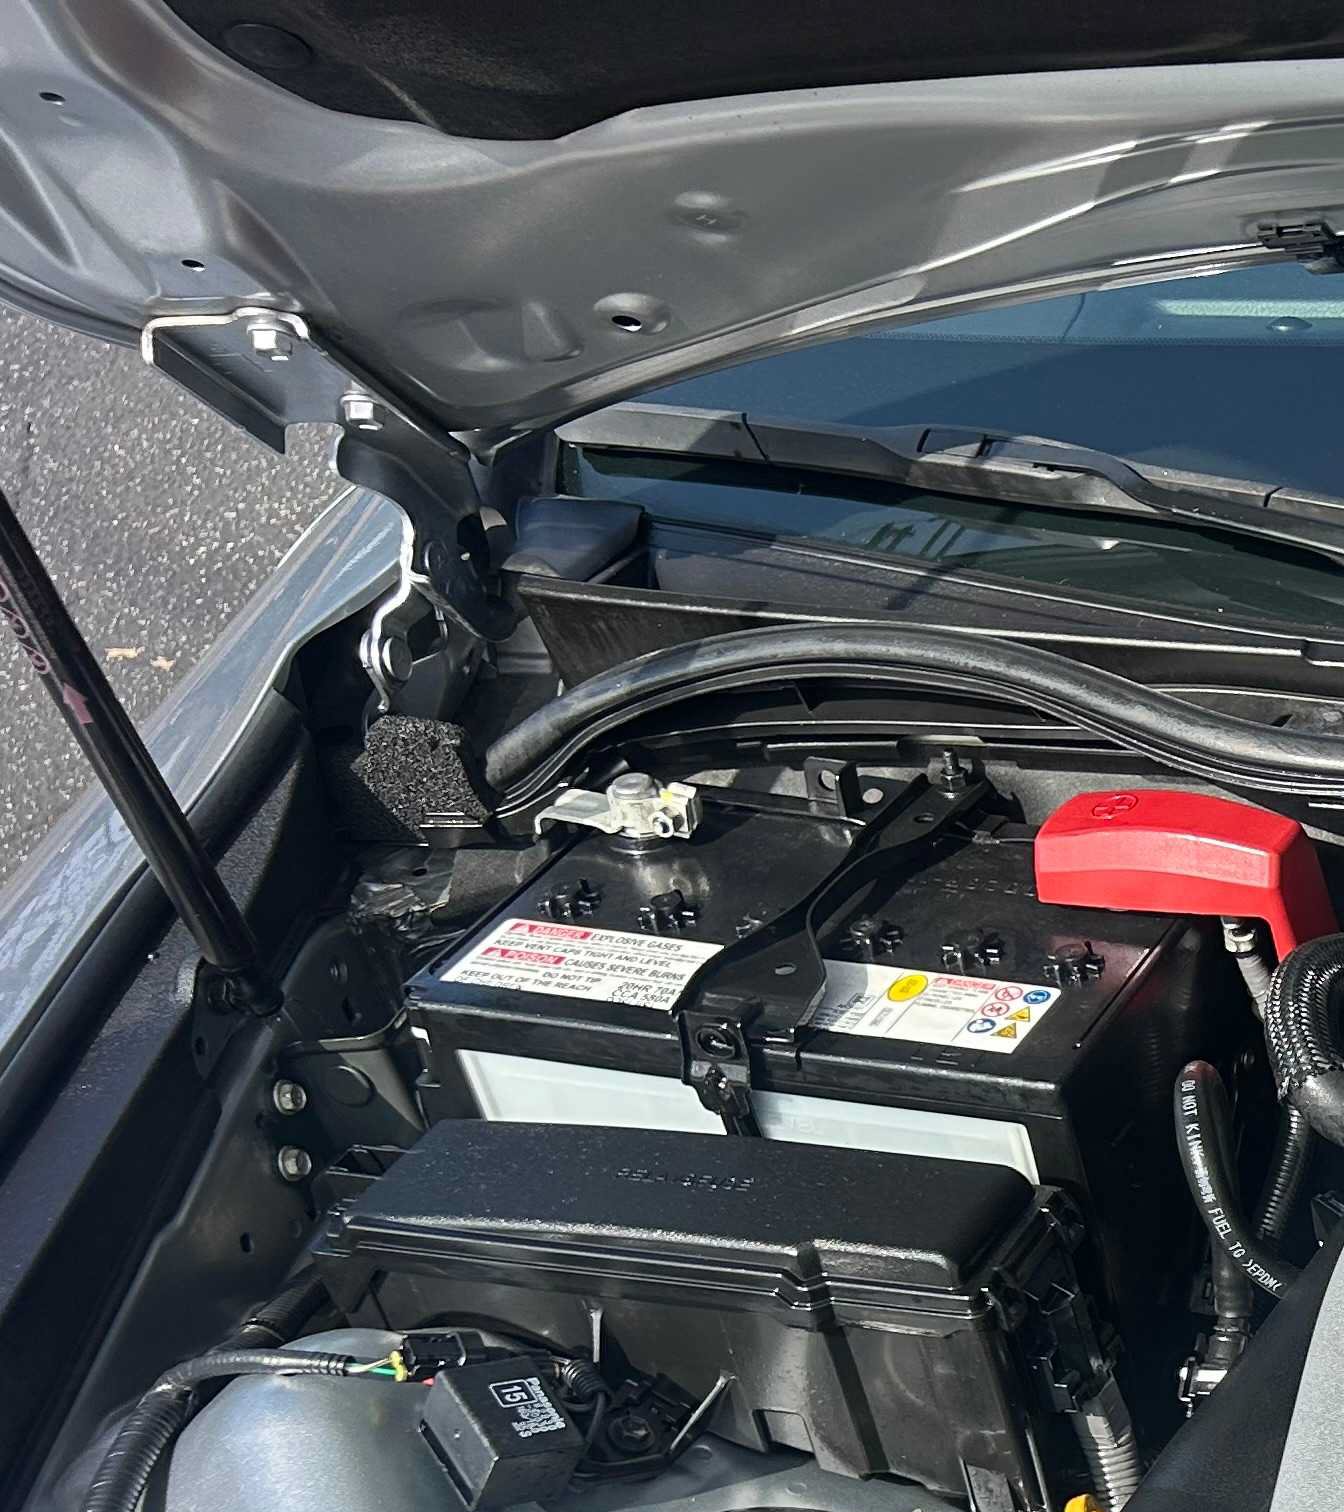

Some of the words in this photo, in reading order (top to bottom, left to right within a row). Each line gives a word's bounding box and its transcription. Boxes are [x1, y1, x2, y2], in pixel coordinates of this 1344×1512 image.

[533, 925, 584, 940] DANGER
[591, 933, 644, 947] EXPLOSIVE
[647, 940, 684, 952] GASES
[494, 939, 522, 947] KEEP
[525, 943, 551, 951] VENT
[584, 949, 613, 960] TIGHT
[615, 953, 639, 963] AND
[640, 957, 672, 968] LEVEL
[505, 951, 557, 965] POISON
[565, 958, 606, 971] CAUSES
[607, 964, 649, 977] SEVERE
[648, 969, 687, 981] BURNS
[542, 971, 559, 979] DO
[561, 974, 583, 982] NOT
[461, 969, 490, 978] KEEP
[491, 972, 514, 981] OUT
[534, 979, 555, 987] THE
[556, 981, 592, 992] REACH
[1181, 1079, 1196, 1093] DO
[1182, 1096, 1198, 1116] NOT
[1208, 1207, 1232, 1240] FUEL
[1228, 1241, 1246, 1259] TO
[500, 1385, 529, 1403] 15
[526, 1377, 566, 1430] Panasonic
